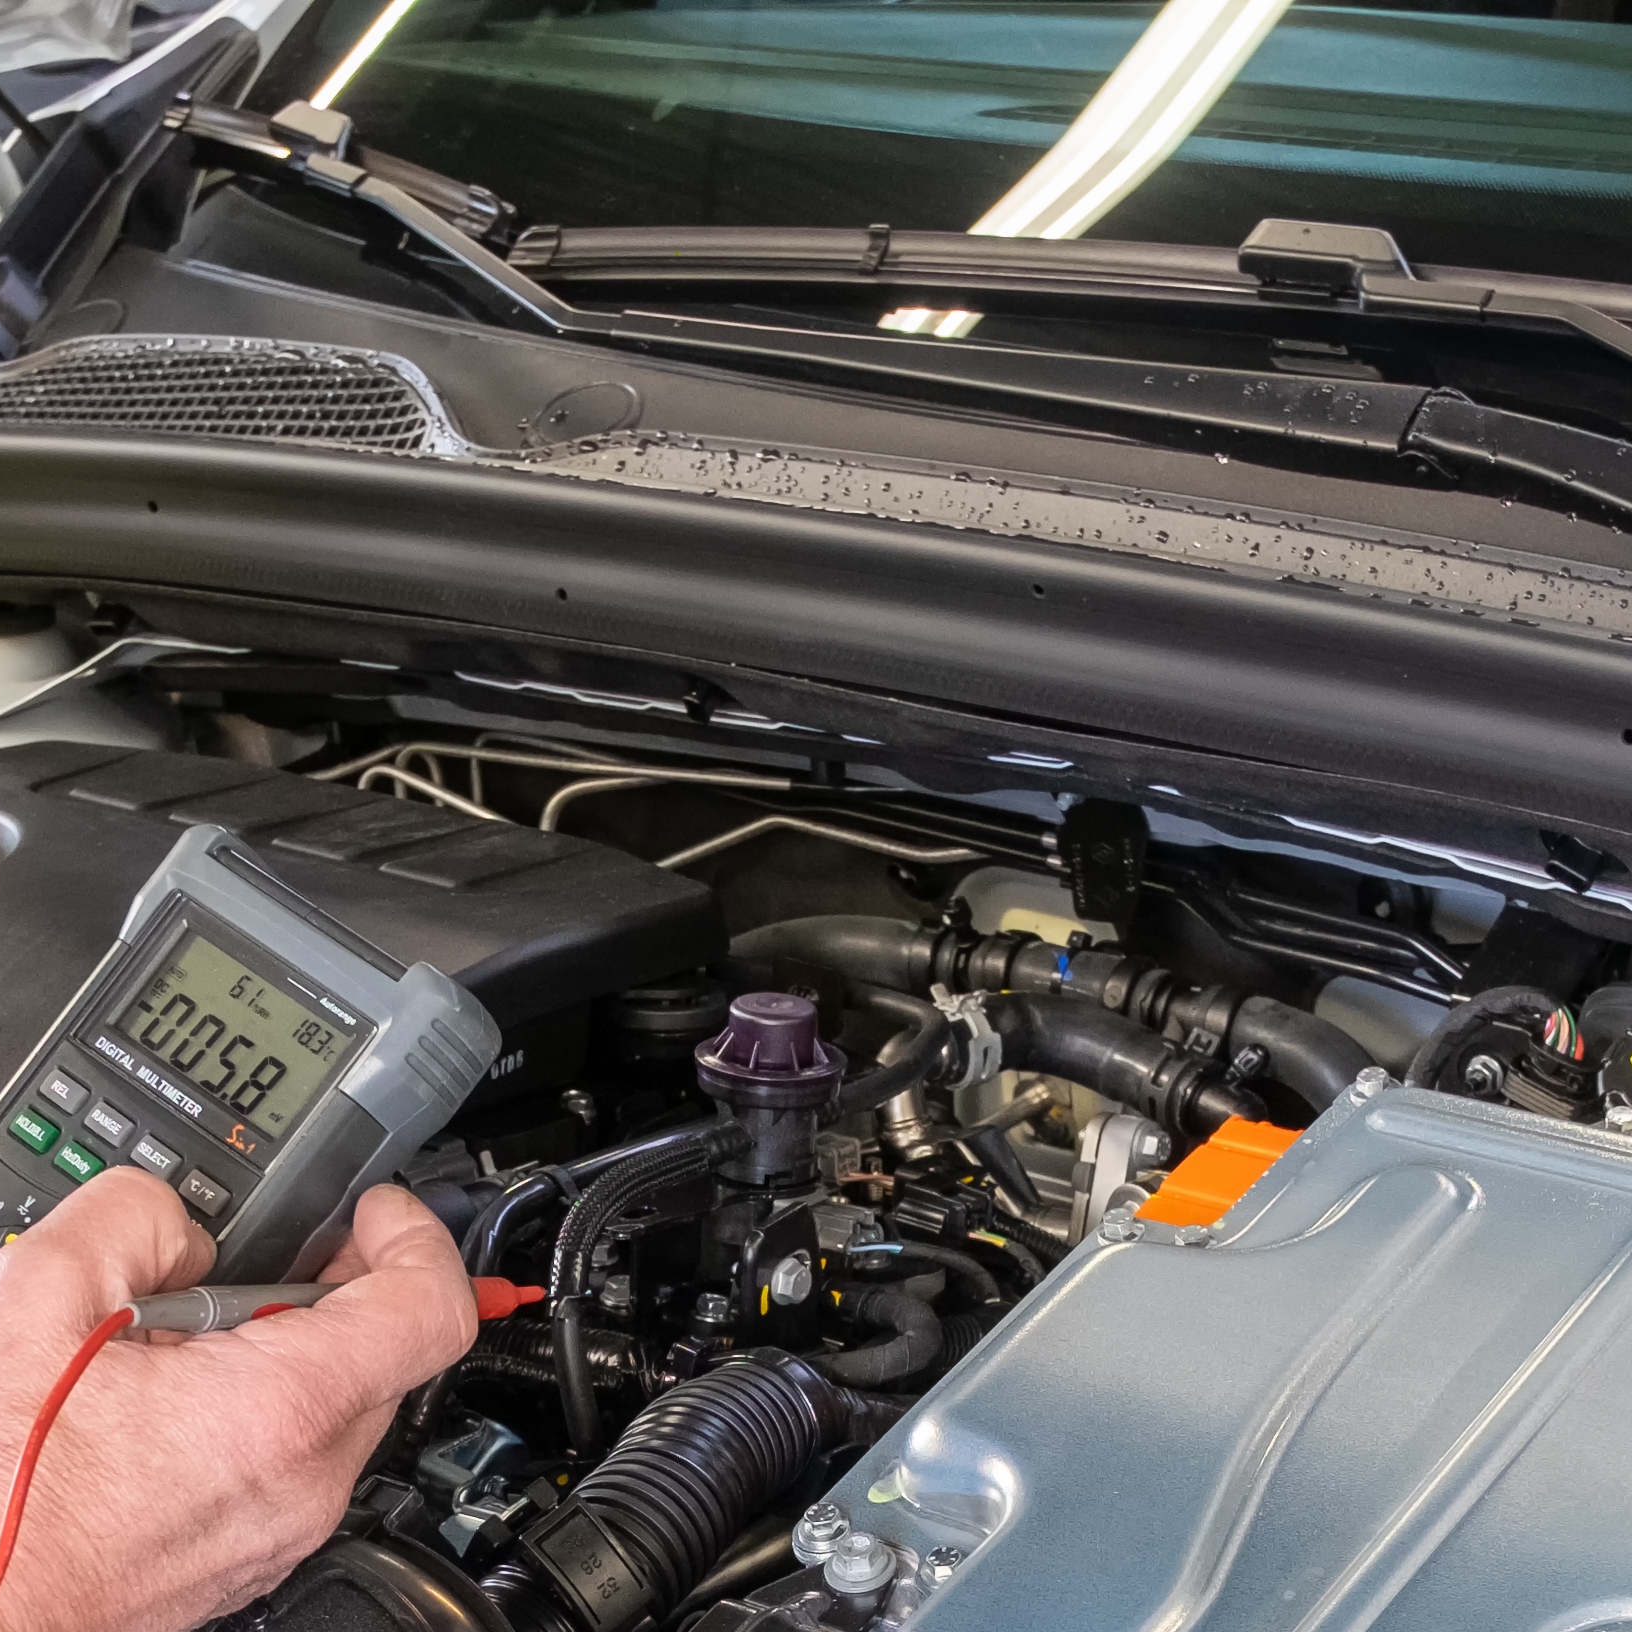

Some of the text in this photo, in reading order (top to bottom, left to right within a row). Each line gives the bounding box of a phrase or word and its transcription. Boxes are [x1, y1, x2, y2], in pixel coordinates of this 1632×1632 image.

[229, 973, 264, 1006] 61
[320, 997, 357, 1026] Autorange
[293, 1019, 334, 1056] 18.3
[138, 993, 287, 1115] -005.8
[51, 1079, 69, 1098] REL
[95, 1037, 202, 1118] DIGITAL MULTIMETER
[92, 1108, 123, 1134] RANGE
[138, 1141, 171, 1169] SELECT
